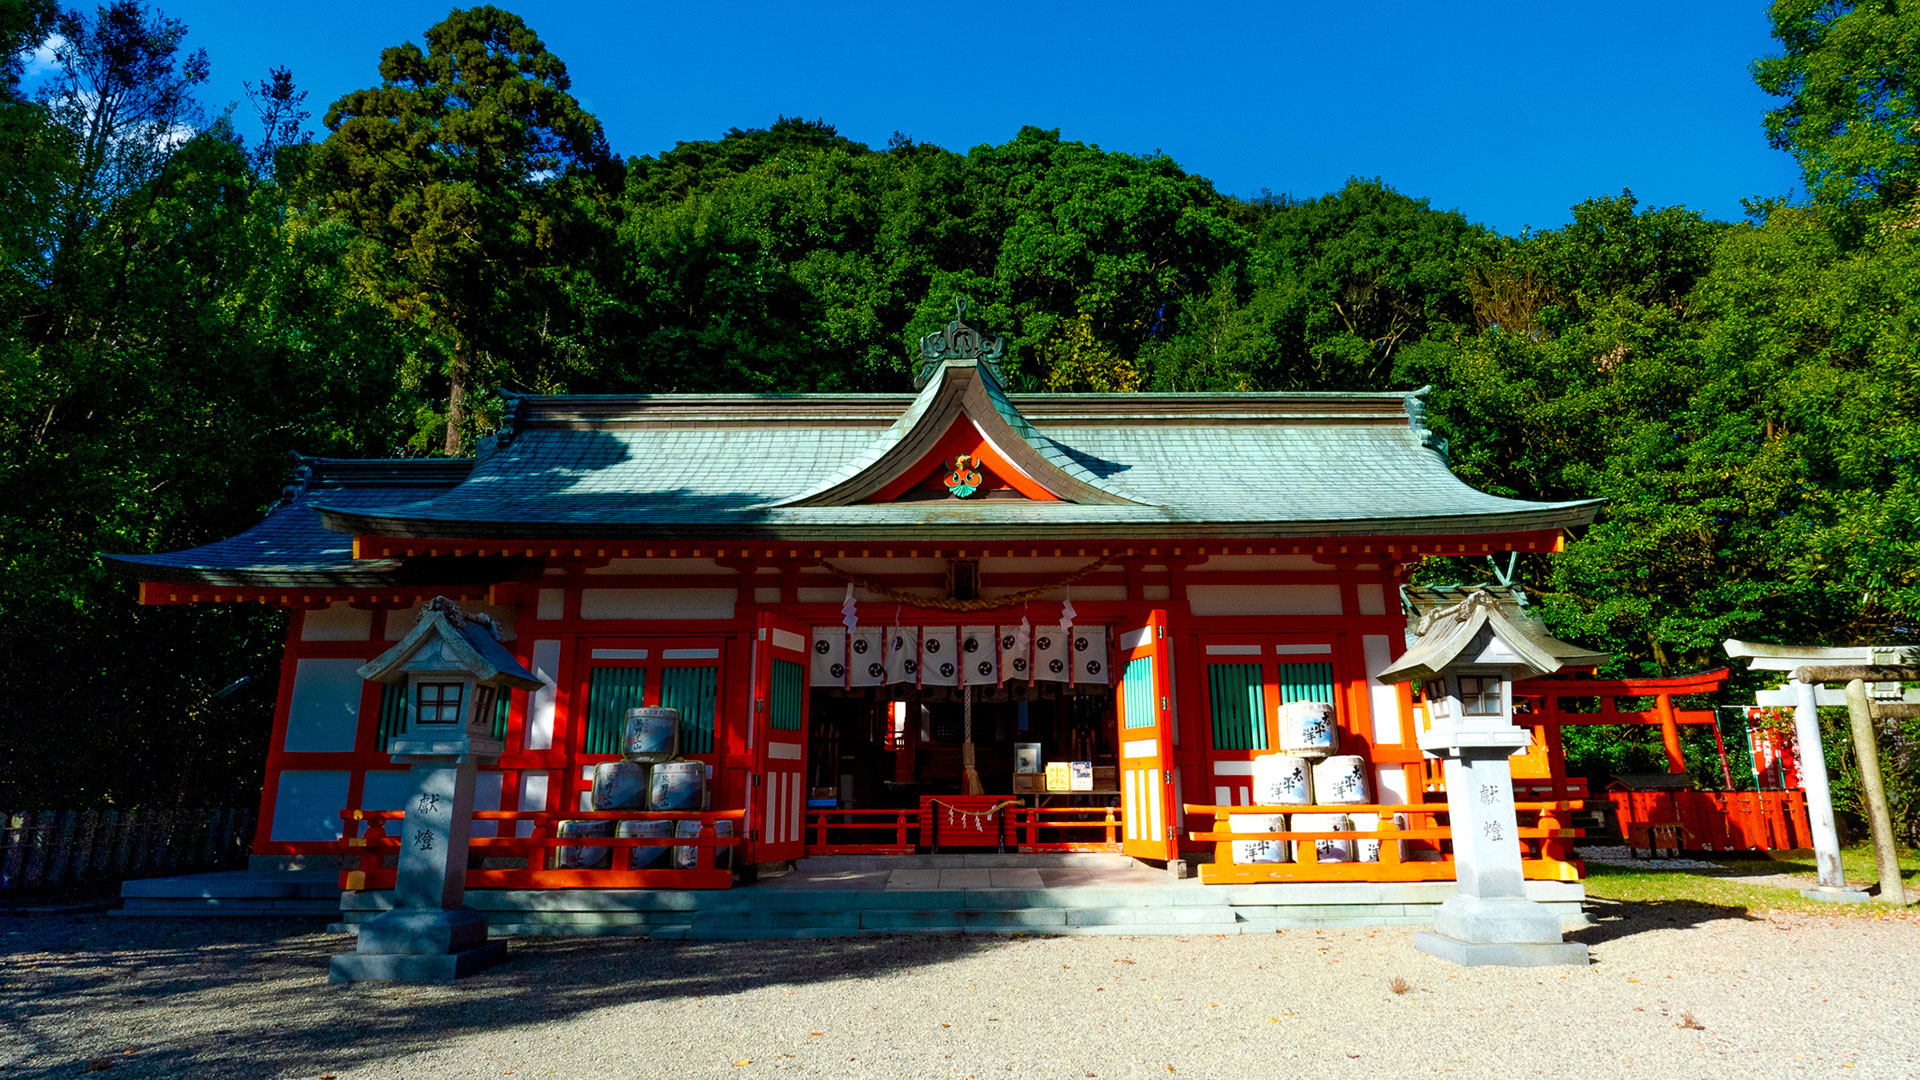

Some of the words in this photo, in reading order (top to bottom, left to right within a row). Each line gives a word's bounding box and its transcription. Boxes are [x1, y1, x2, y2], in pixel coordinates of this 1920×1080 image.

[1302, 711, 1331, 745] 太平洋
[1271, 767, 1303, 800] 太平洋
[1333, 765, 1362, 799] 太平洋
